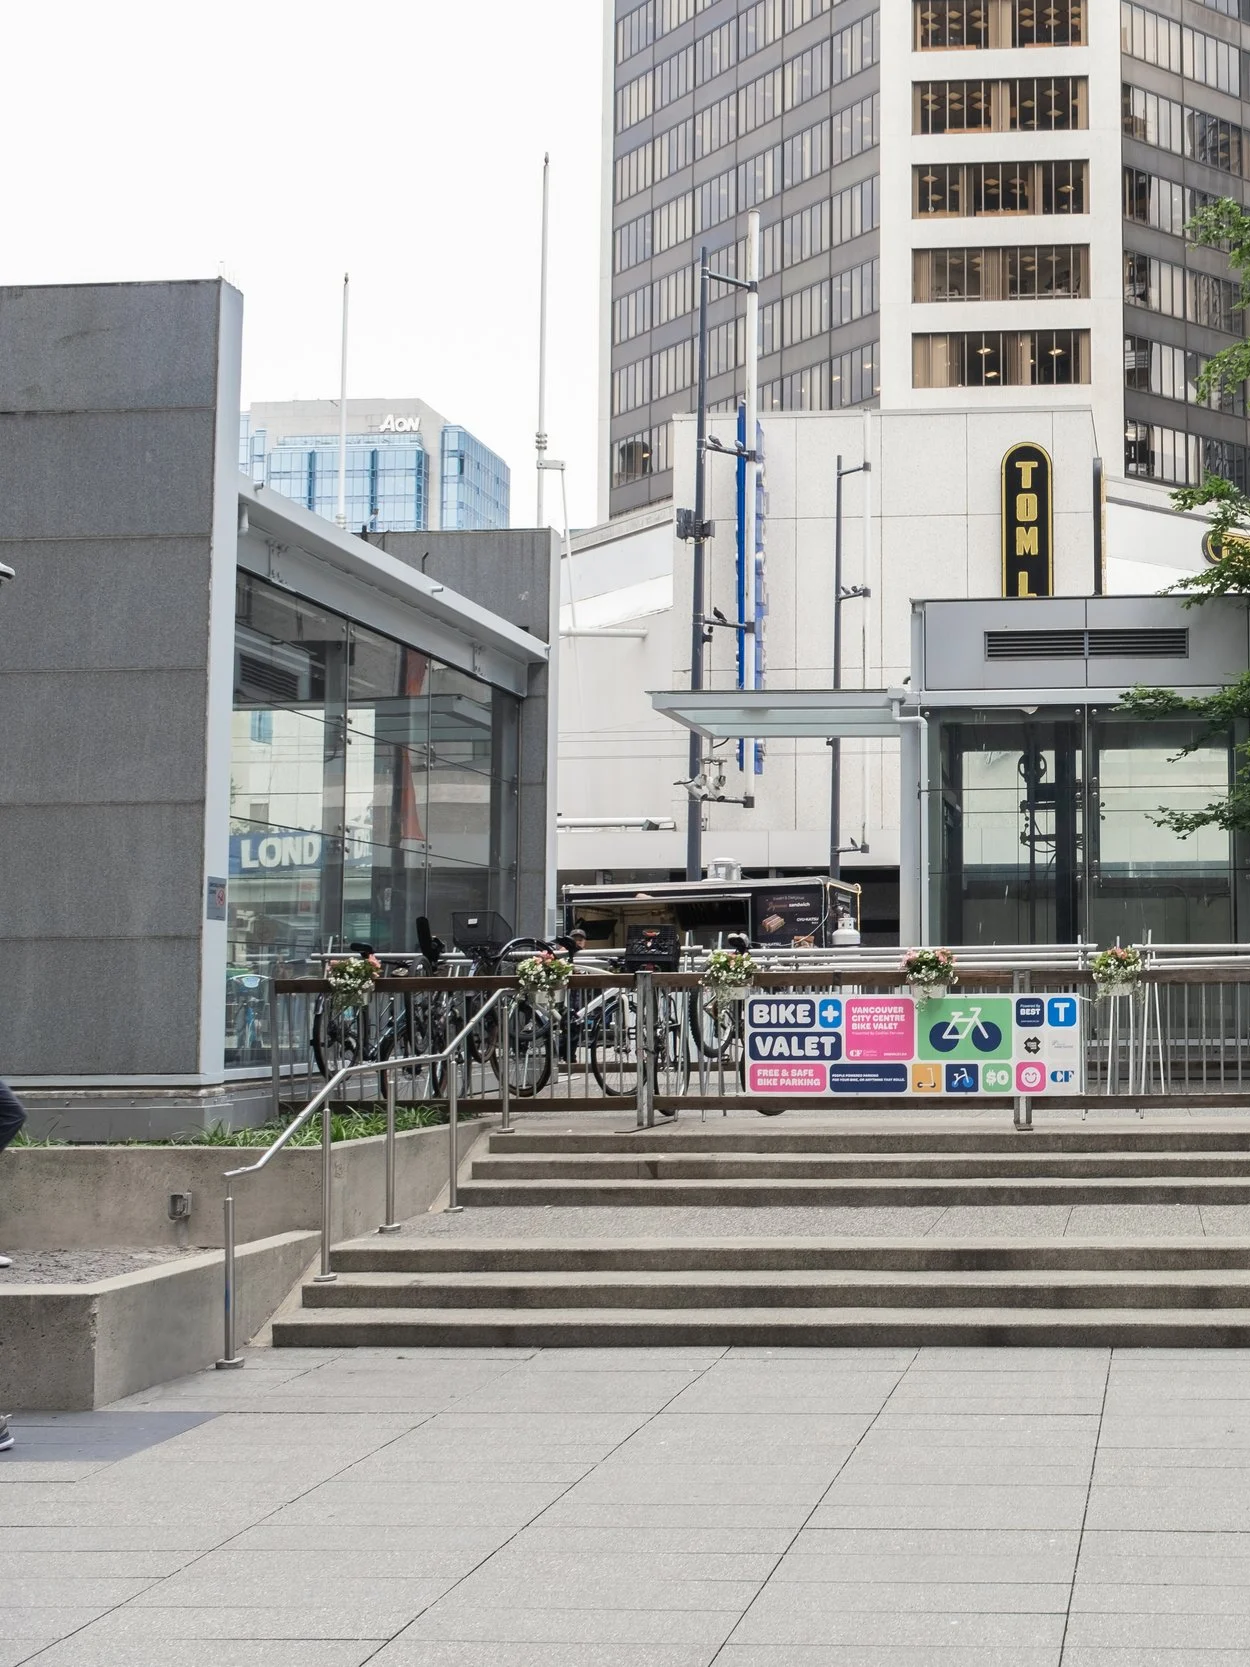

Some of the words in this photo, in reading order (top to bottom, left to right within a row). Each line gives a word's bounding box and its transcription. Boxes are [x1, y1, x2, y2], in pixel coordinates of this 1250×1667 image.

[379, 414, 420, 432] AON
[1015, 461, 1038, 556] TOM
[241, 835, 322, 868] LOND
[753, 1003, 812, 1024] BIKE
[851, 1006, 905, 1014] VANCOUVER
[851, 1014, 872, 1022] CITY
[872, 1014, 906, 1022] CENTRE
[1053, 1002, 1070, 1022] T
[851, 1022, 872, 1030] BIKE
[873, 1022, 899, 1030] VALET
[755, 1036, 836, 1057] VALET
[757, 1069, 779, 1077] FREE
[781, 1069, 790, 1077] &
[791, 1069, 814, 1077] SAFE
[986, 1069, 1010, 1086] $0
[1050, 1070, 1075, 1083] CF
[757, 1078, 778, 1086] BIKE
[780, 1078, 821, 1086] PARKING
